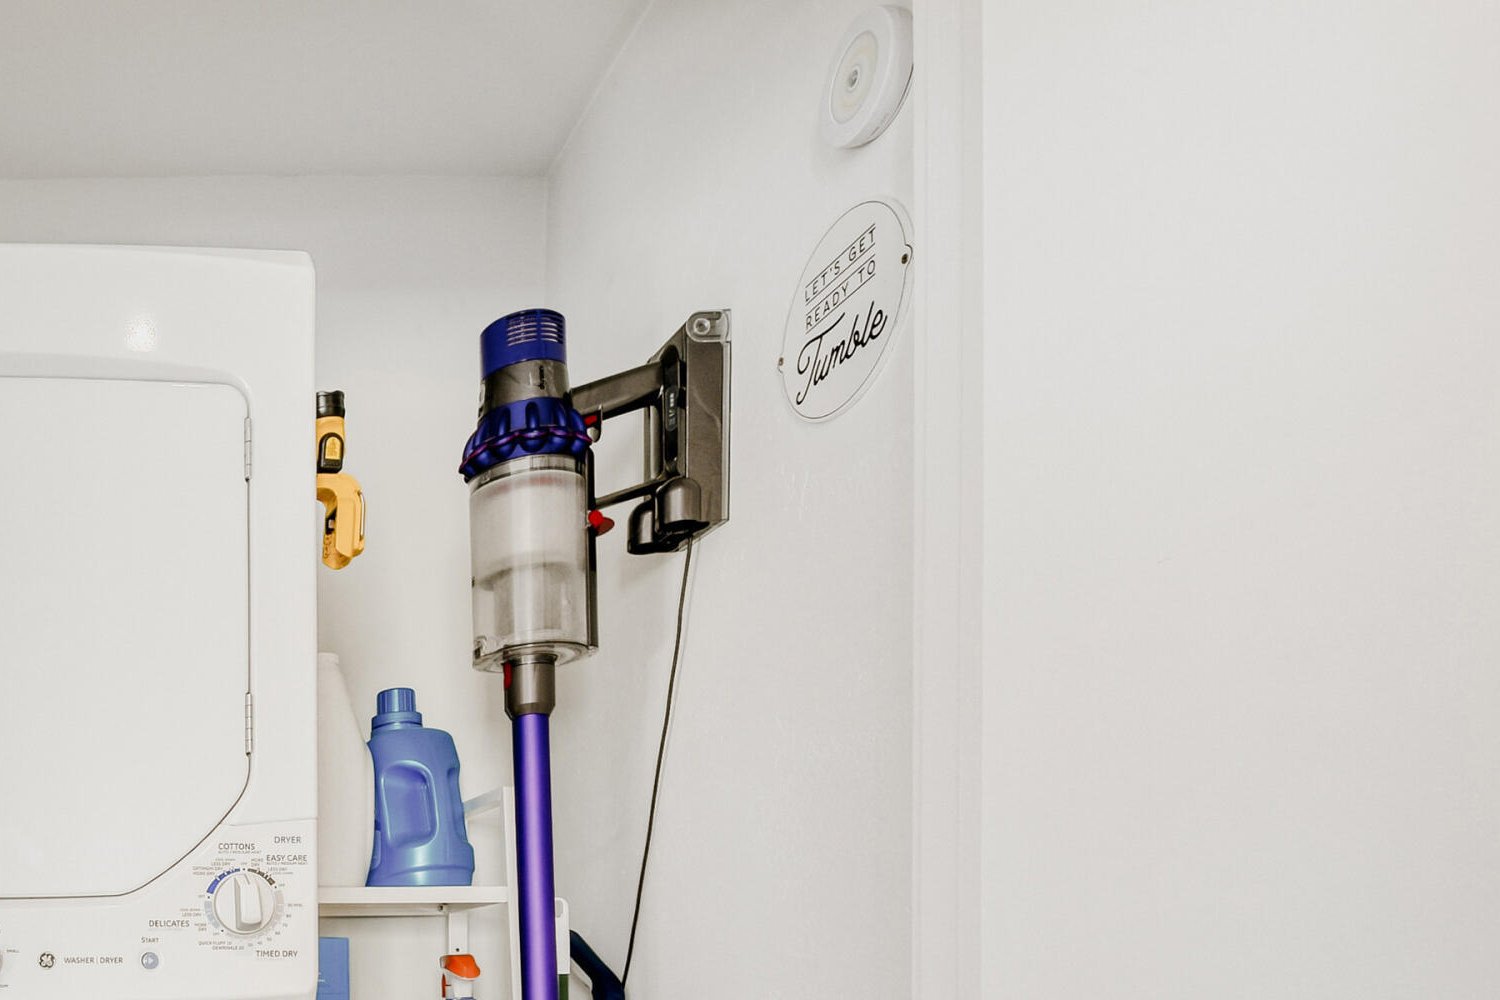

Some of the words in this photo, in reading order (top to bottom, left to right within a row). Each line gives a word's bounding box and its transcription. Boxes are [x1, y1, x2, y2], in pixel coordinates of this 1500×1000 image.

[804, 260, 842, 302] LET'S
[848, 227, 877, 263] GET
[805, 282, 850, 330] READY
[857, 259, 877, 284] TO
[795, 300, 889, 406] Tumble
[274, 836, 302, 844] DRYER
[218, 843, 256, 851] COTTONS
[266, 854, 285, 862] EASY
[287, 854, 308, 862] CARE
[148, 919, 190, 928] DELICATES
